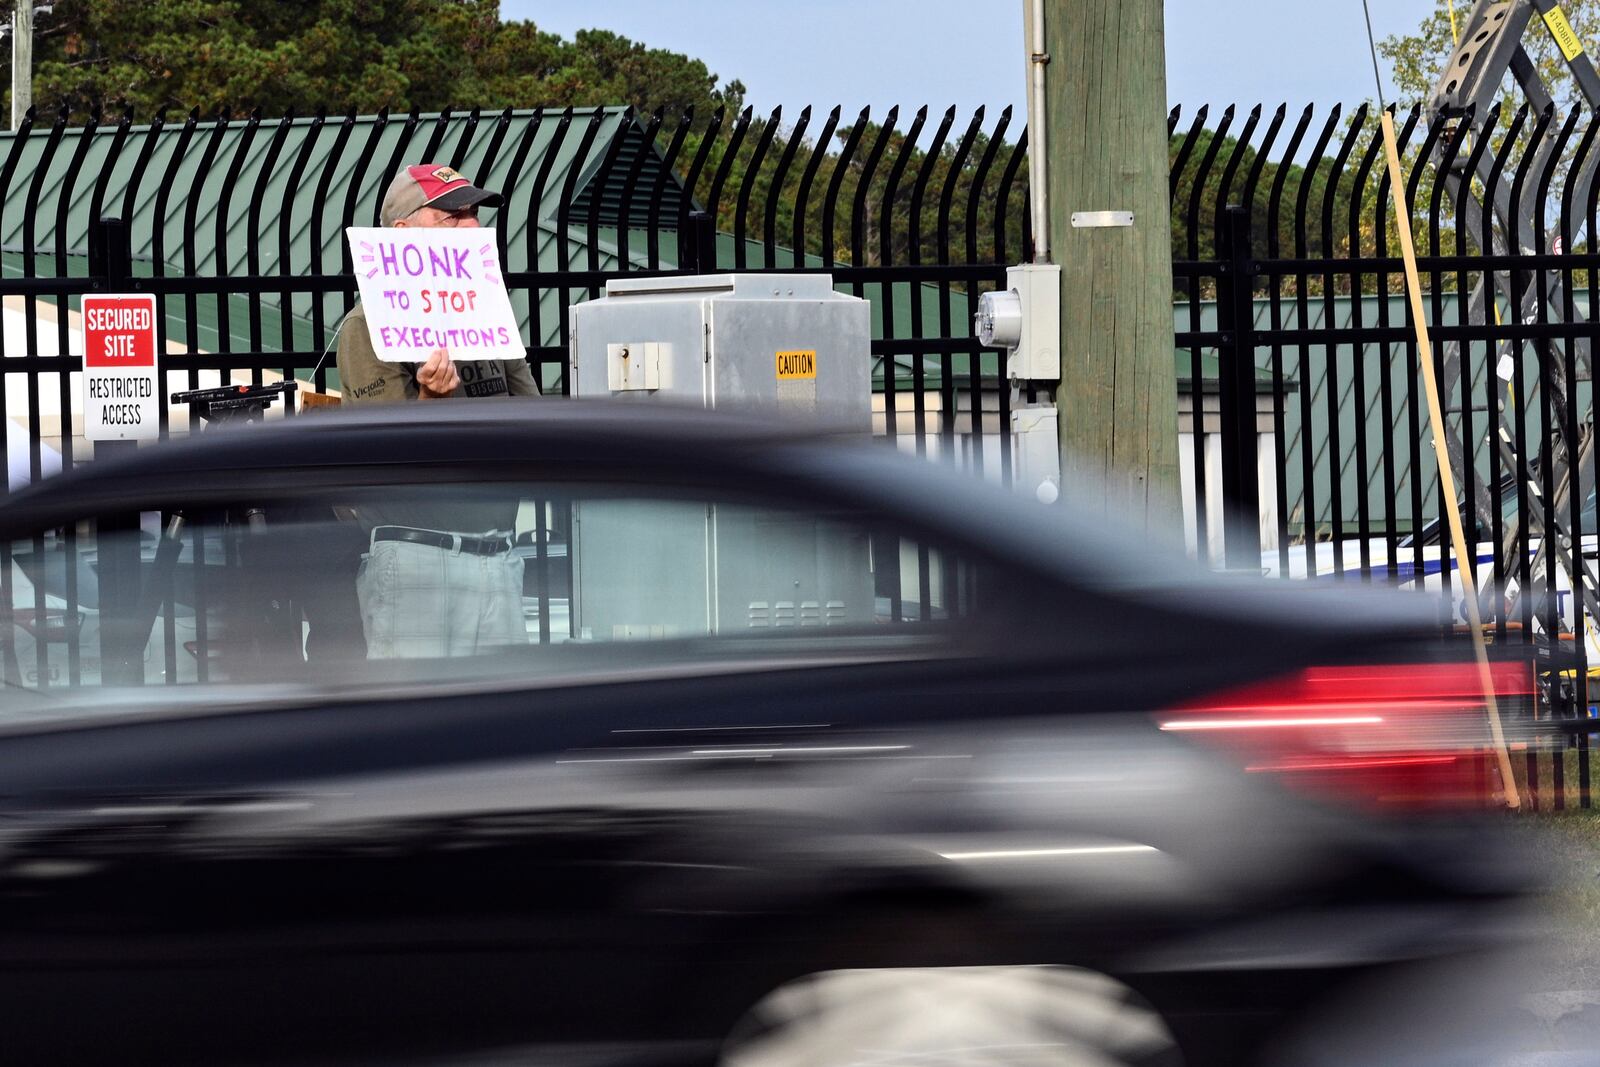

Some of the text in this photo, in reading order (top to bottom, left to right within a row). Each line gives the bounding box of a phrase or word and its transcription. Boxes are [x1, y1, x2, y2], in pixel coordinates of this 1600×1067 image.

[379, 243, 473, 280] HONK
[383, 289, 477, 314] TO STOP
[87, 308, 151, 331] SECURED
[104, 335, 136, 357] SITE
[380, 326, 510, 349] EXECUTIONS
[460, 360, 484, 383] OF
[778, 354, 813, 375] CAUTION
[89, 377, 152, 398] RESTRICTED
[102, 404, 142, 425] ACCESS
